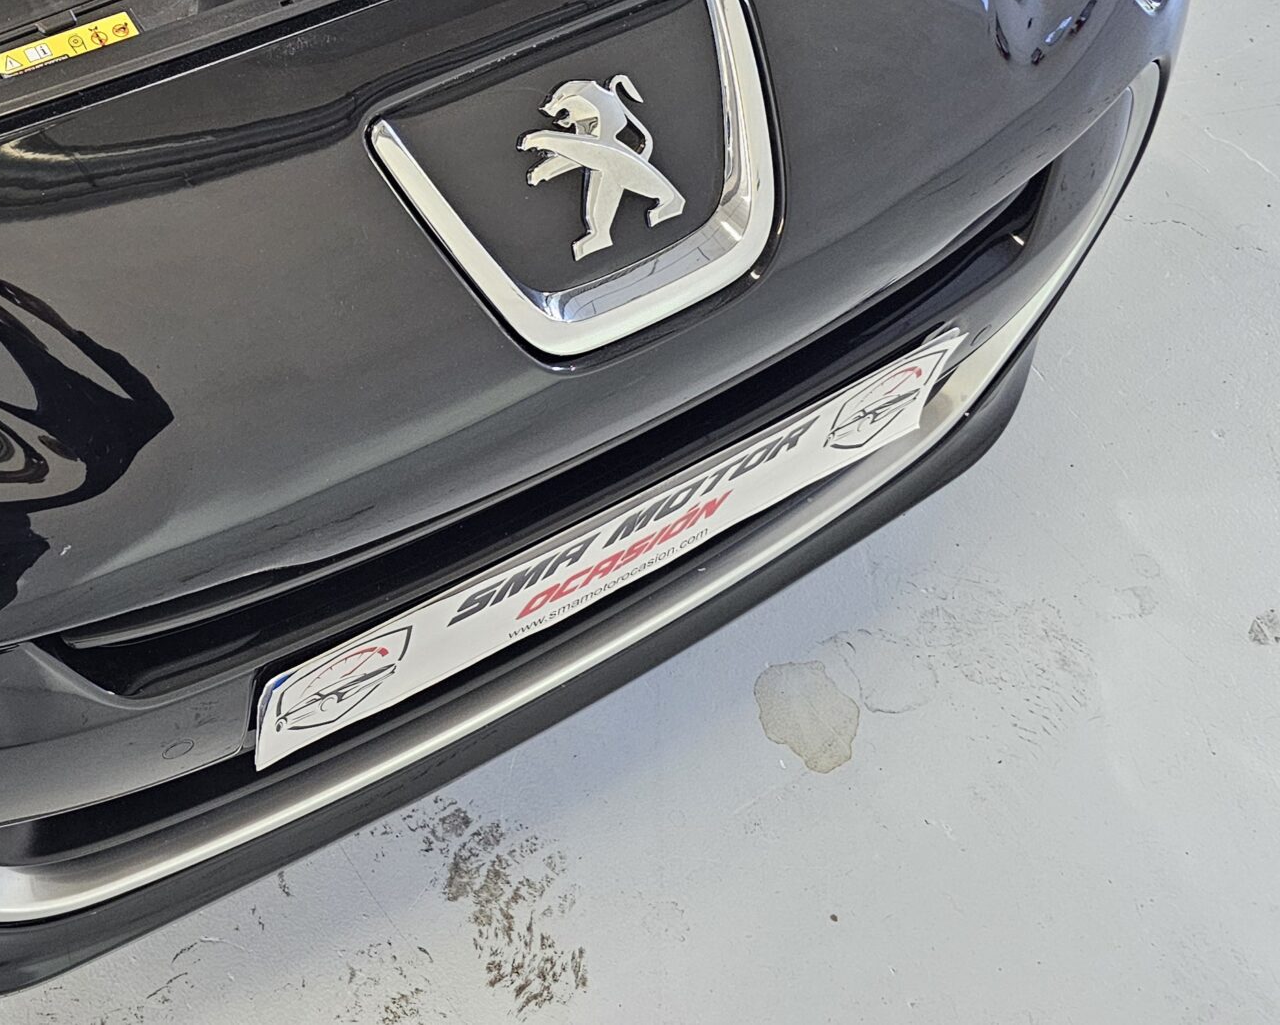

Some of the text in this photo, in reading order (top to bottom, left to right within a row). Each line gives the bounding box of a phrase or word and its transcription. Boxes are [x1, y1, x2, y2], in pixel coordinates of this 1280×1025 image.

[446, 415, 820, 627] SMA MOTOR
[508, 527, 709, 640] www.smamotorocasion.com
[515, 490, 733, 621] OCASIÓN
